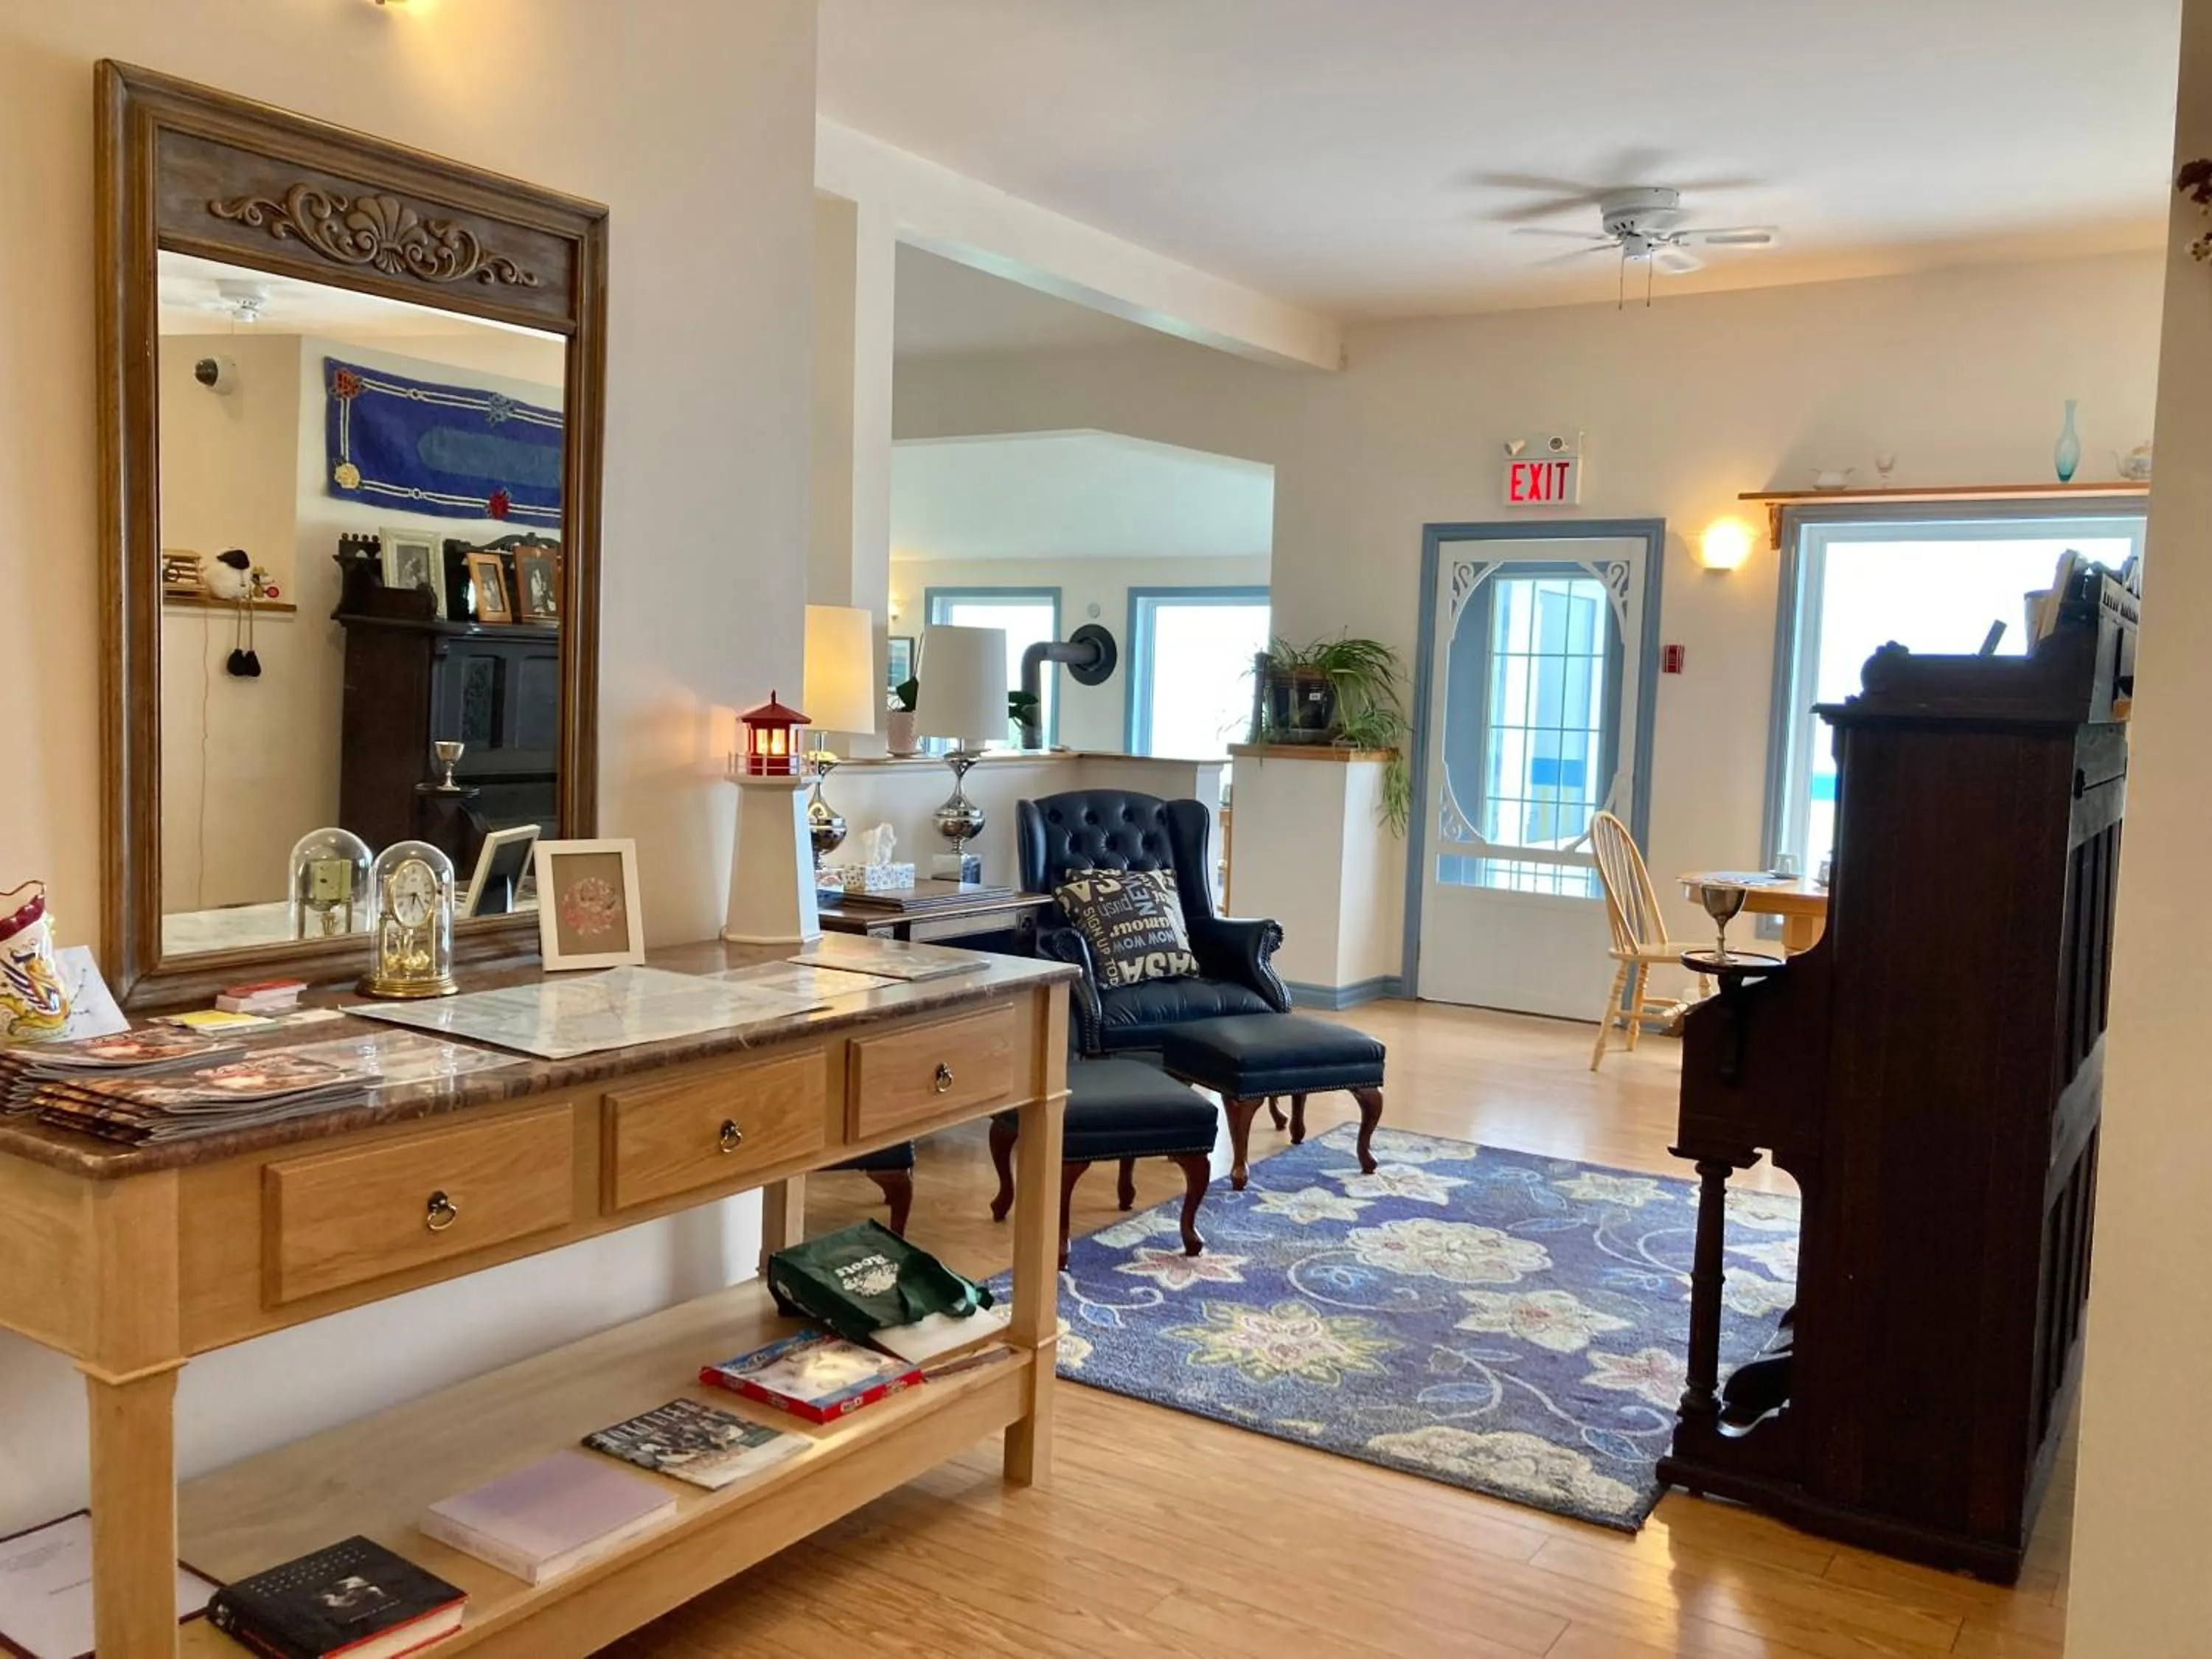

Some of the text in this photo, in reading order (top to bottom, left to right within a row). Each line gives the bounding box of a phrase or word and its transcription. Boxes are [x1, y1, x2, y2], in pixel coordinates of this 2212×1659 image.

[1510, 462, 1570, 501] EXIT
[1097, 894, 1133, 918] push
[1083, 906, 1104, 937] SIGN
[1097, 936, 1110, 956] UP
[1112, 936, 1146, 953] WOW
